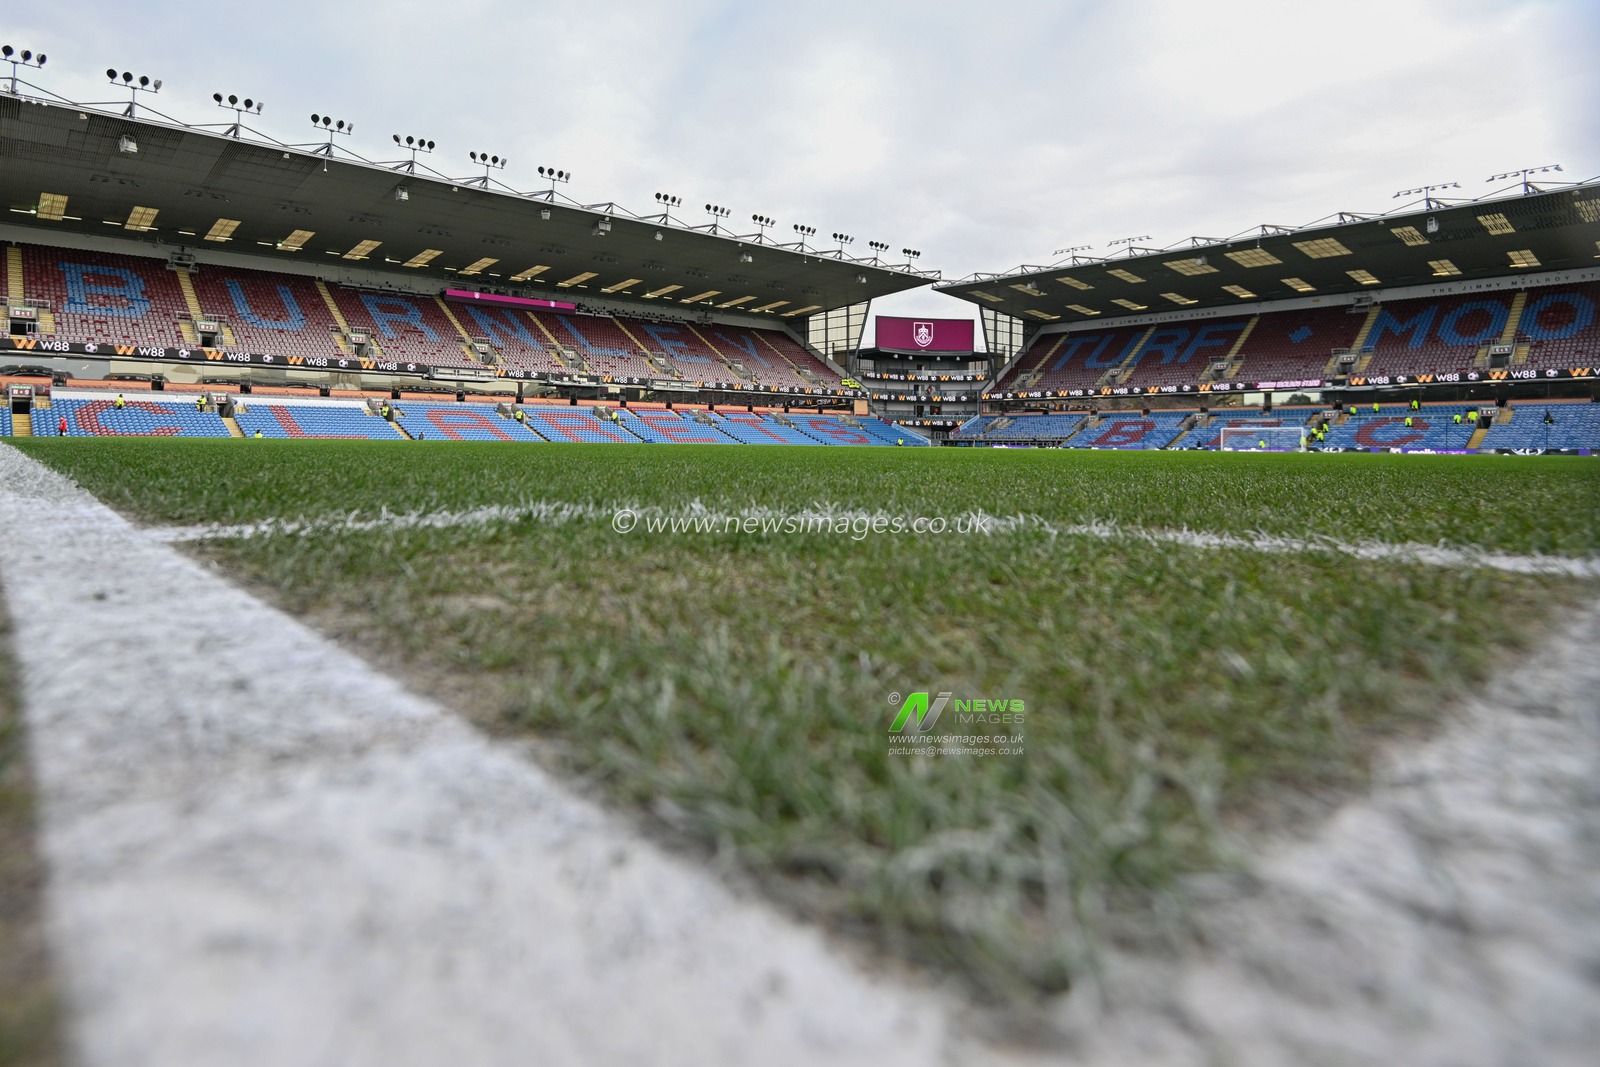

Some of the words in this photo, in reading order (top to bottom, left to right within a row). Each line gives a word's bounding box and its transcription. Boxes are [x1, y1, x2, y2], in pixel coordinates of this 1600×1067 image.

[1462, 282, 1501, 291] JIMMY
[58, 261, 772, 369] BURNLEY
[40, 341, 70, 351] W88
[1052, 322, 1249, 371] TURF
[139, 347, 165, 357] W88
[227, 352, 250, 362] W88
[307, 357, 327, 366] W88
[378, 362, 397, 371] W88
[508, 370, 524, 378] W88
[1436, 373, 1459, 382] W88
[1511, 370, 1537, 379] W88
[614, 376, 627, 384] W88
[1368, 376, 1389, 384] W88
[1212, 383, 1230, 391] W88
[74, 400, 870, 444] CLARETS
[1088, 418, 1431, 447] BFC
